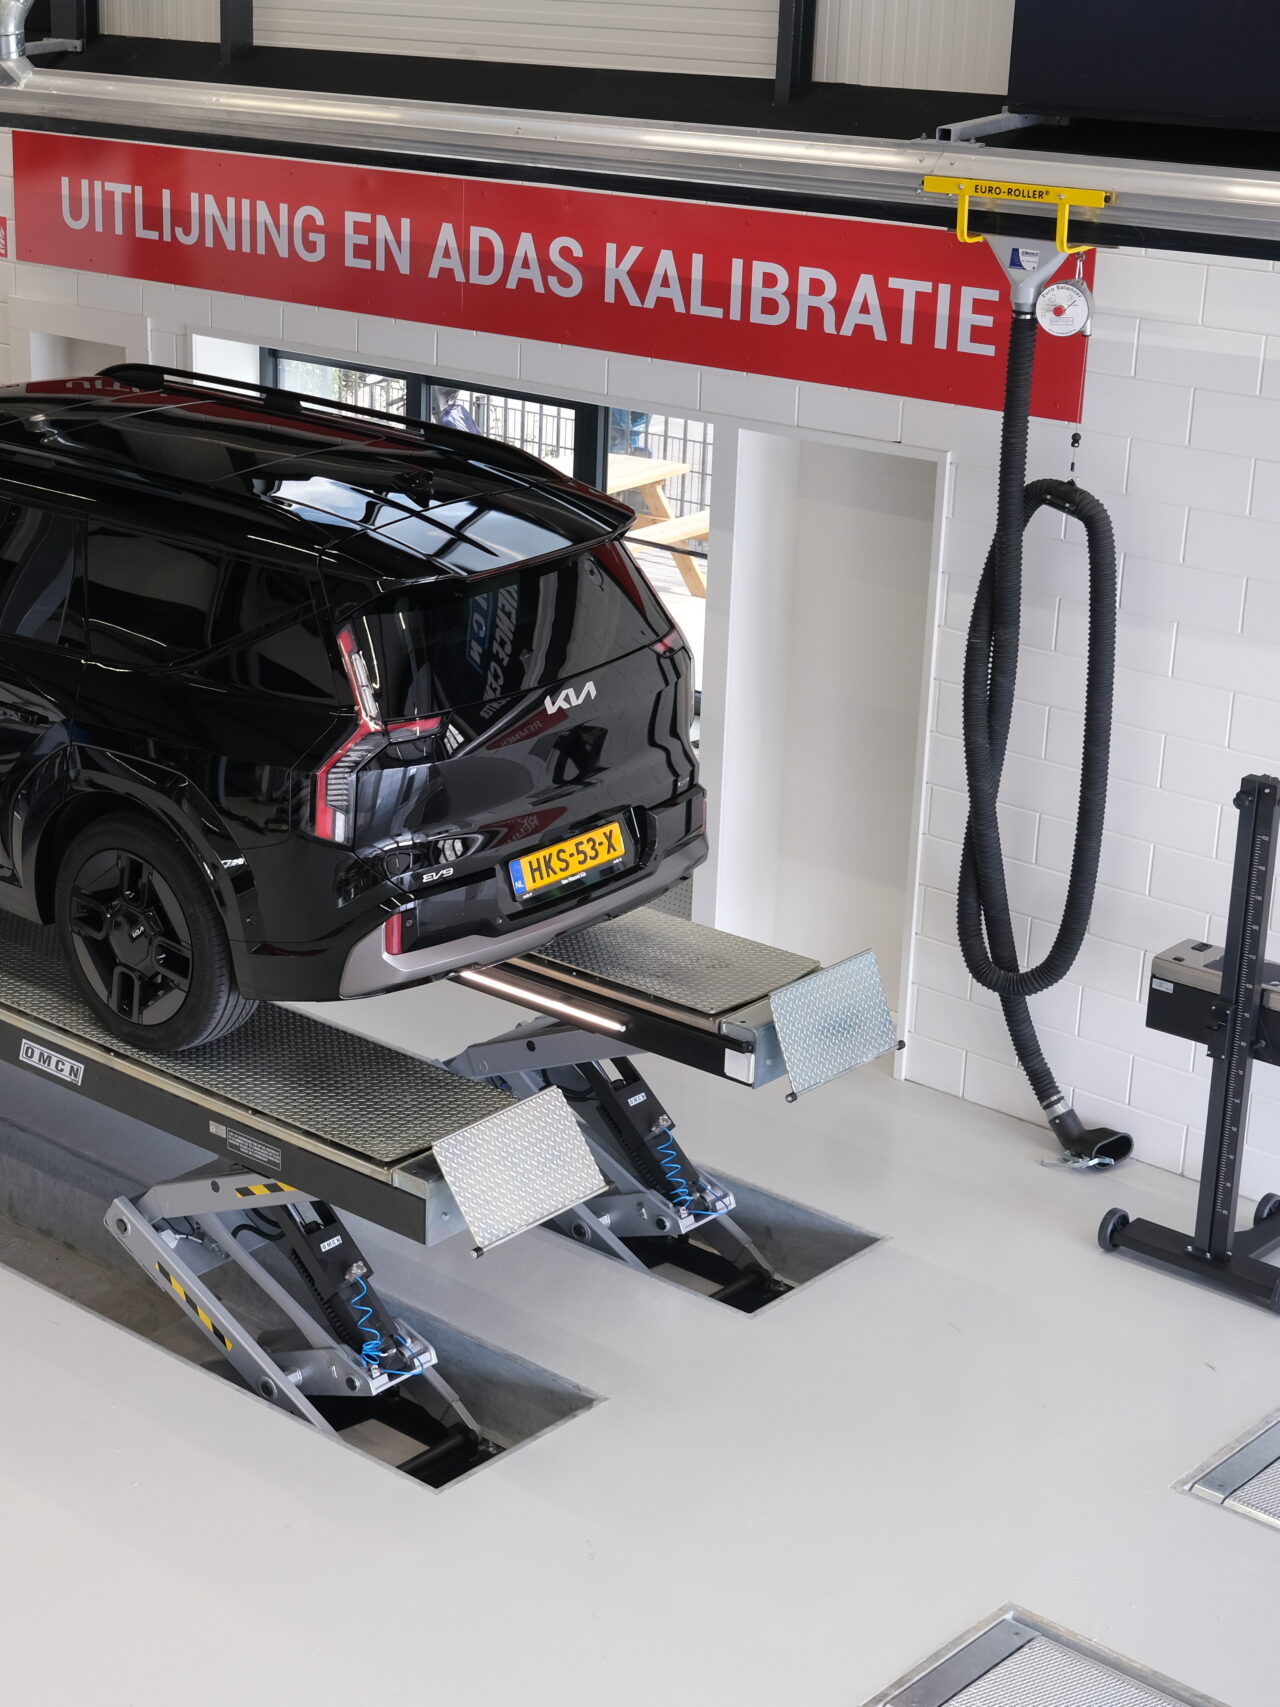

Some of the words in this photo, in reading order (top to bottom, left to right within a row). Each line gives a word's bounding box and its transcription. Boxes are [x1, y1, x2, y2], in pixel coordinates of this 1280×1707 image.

[61, 176, 326, 263] UITLIJNING
[344, 210, 411, 275] EN
[428, 222, 583, 299] ADAS
[604, 242, 1001, 357] KALIBRATIE
[544, 680, 597, 715] KIA
[528, 829, 618, 884] HKS-53-X
[422, 867, 454, 883] EV9
[515, 881, 525, 889] NL
[24, 1046, 80, 1080] OMCN
